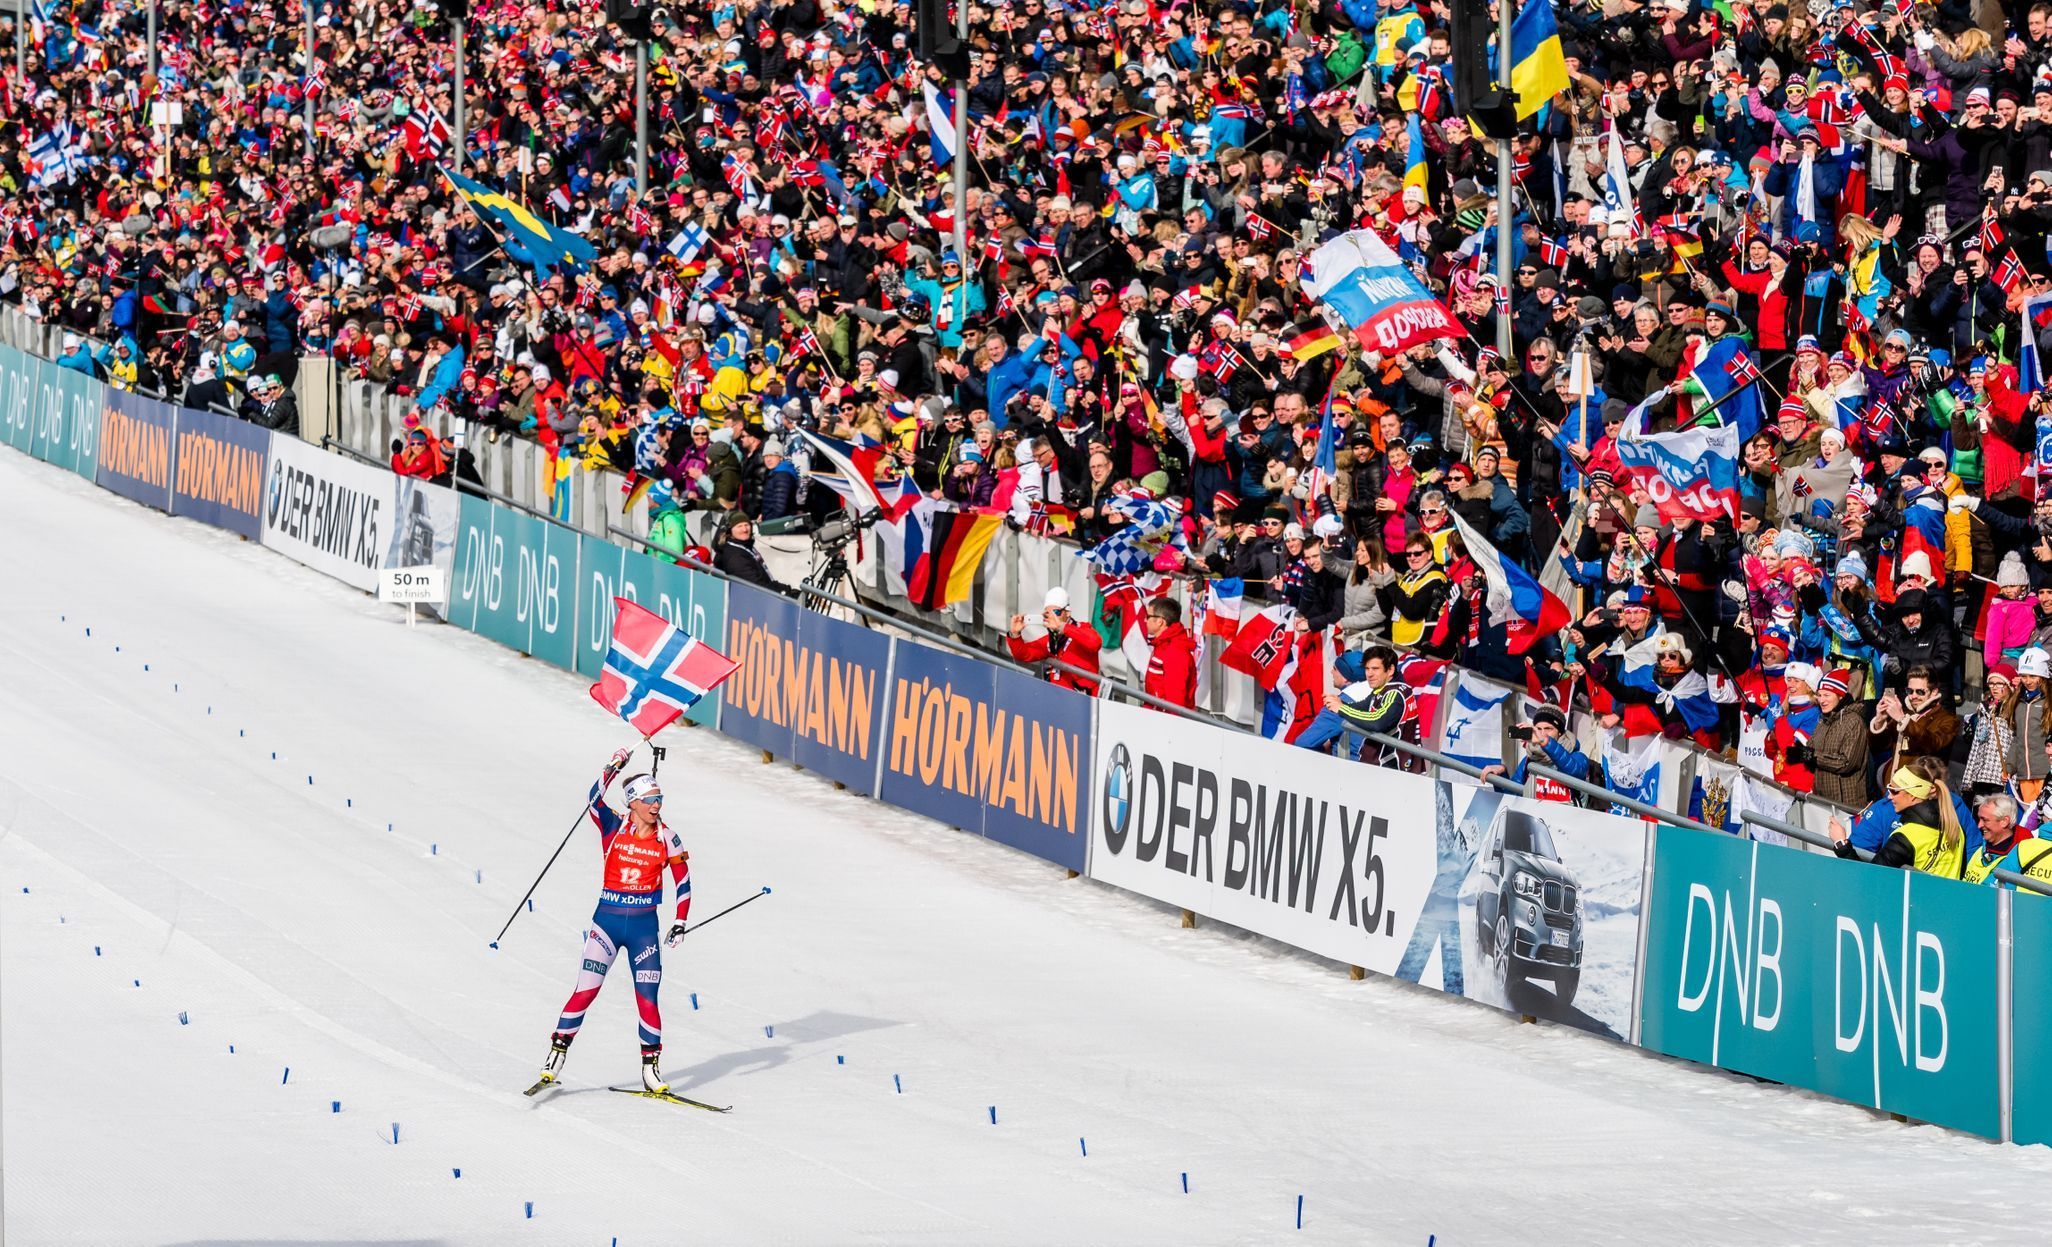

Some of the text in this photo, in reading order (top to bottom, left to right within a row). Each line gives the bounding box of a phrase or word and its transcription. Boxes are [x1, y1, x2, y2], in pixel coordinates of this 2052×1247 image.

[6, 352, 30, 446] DNB
[39, 365, 95, 473] DNB DNB
[101, 405, 169, 489] HÖRMANN
[176, 428, 263, 518] HÖRMANN
[280, 465, 380, 570] DER BMW X5.
[392, 589, 431, 599] to finish
[393, 573, 430, 586] 50 m
[462, 503, 504, 632] DNB
[516, 521, 560, 655] DNB
[726, 616, 876, 761] HÖRMANN
[890, 676, 1079, 834] HÖRMANN
[620, 866, 642, 884] 12
[1136, 753, 1396, 938] DER BMW X5.
[621, 895, 652, 905] xDrive
[637, 970, 659, 983] DNB
[1677, 841, 1949, 1110] DNB DNB
